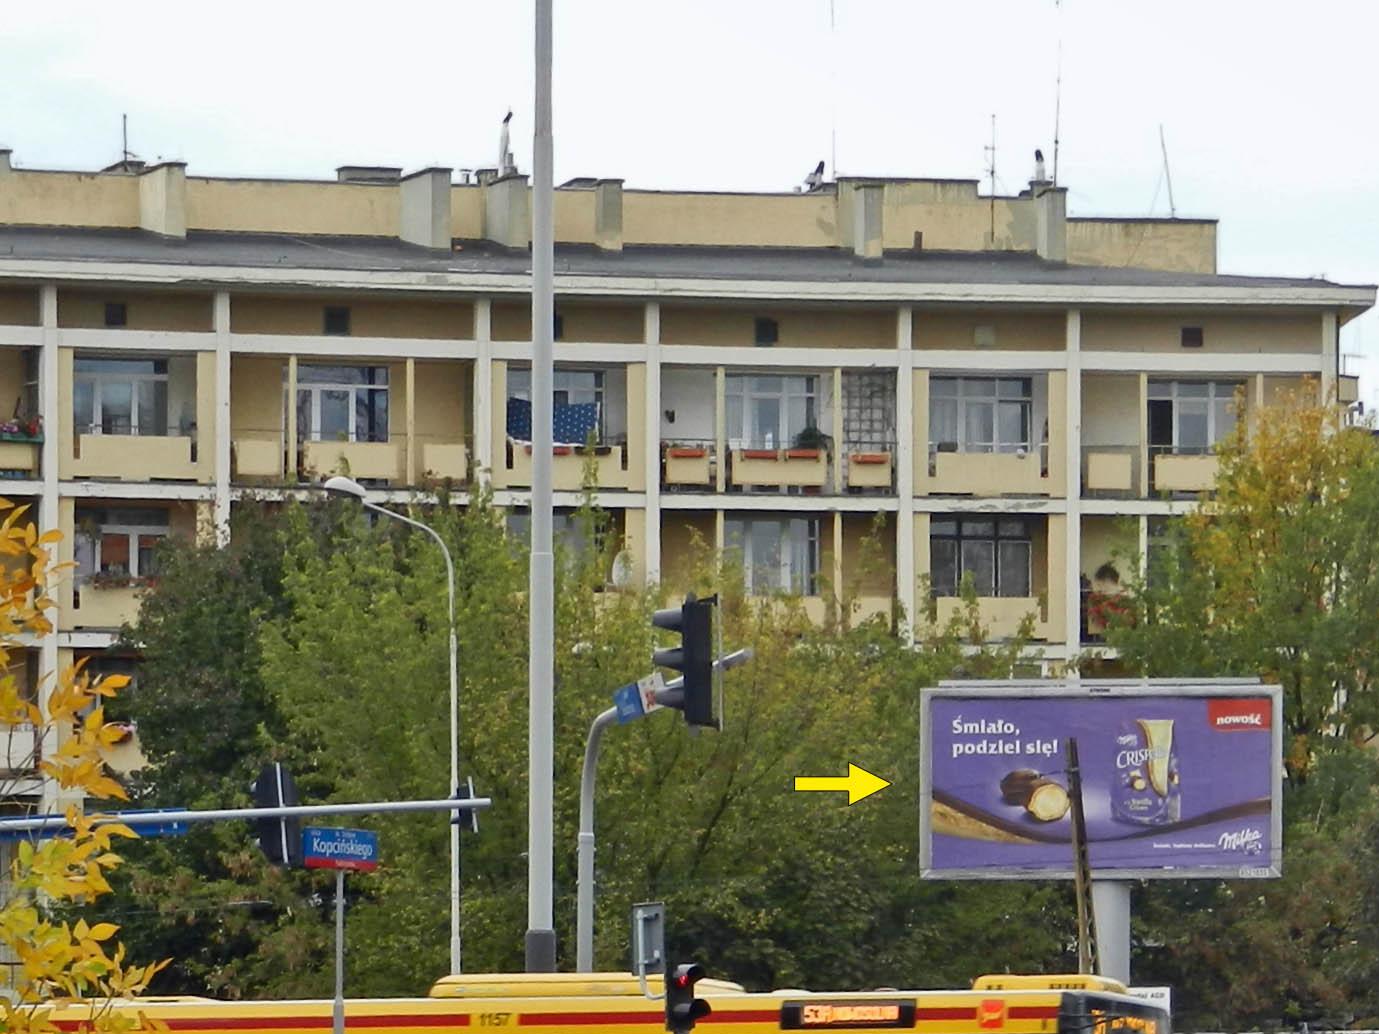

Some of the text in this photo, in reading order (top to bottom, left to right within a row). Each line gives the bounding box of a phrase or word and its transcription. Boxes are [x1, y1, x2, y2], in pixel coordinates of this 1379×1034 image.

[952, 714, 1020, 736] Śmiało,
[1216, 713, 1262, 725] nowość
[952, 739, 1058, 758] podziel się!
[312, 837, 373, 859] Kopcińskiego
[1218, 828, 1262, 850] Milka
[479, 1013, 511, 1026] 1157
